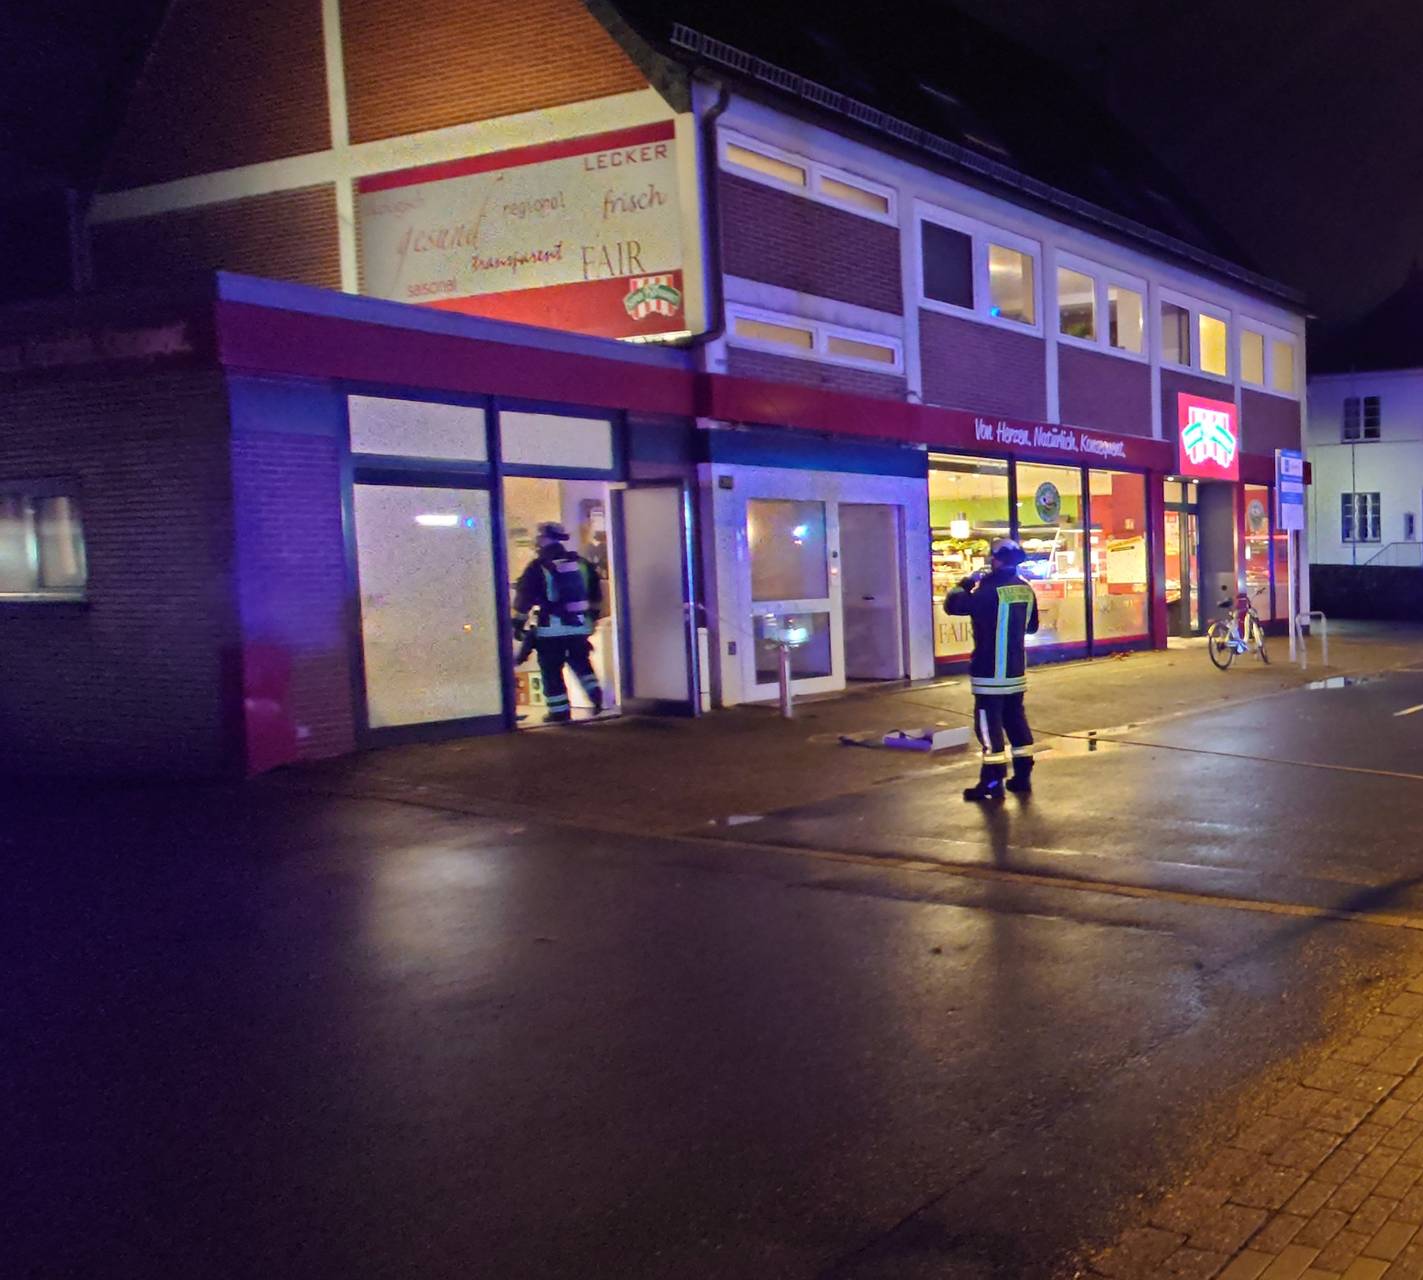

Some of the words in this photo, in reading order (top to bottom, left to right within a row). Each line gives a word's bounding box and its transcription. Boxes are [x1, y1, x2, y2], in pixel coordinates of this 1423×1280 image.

[583, 143, 668, 172] LECKER
[503, 190, 566, 219] regional
[602, 183, 666, 220] frisch
[581, 240, 646, 280] FAIR
[974, 417, 994, 441] Von
